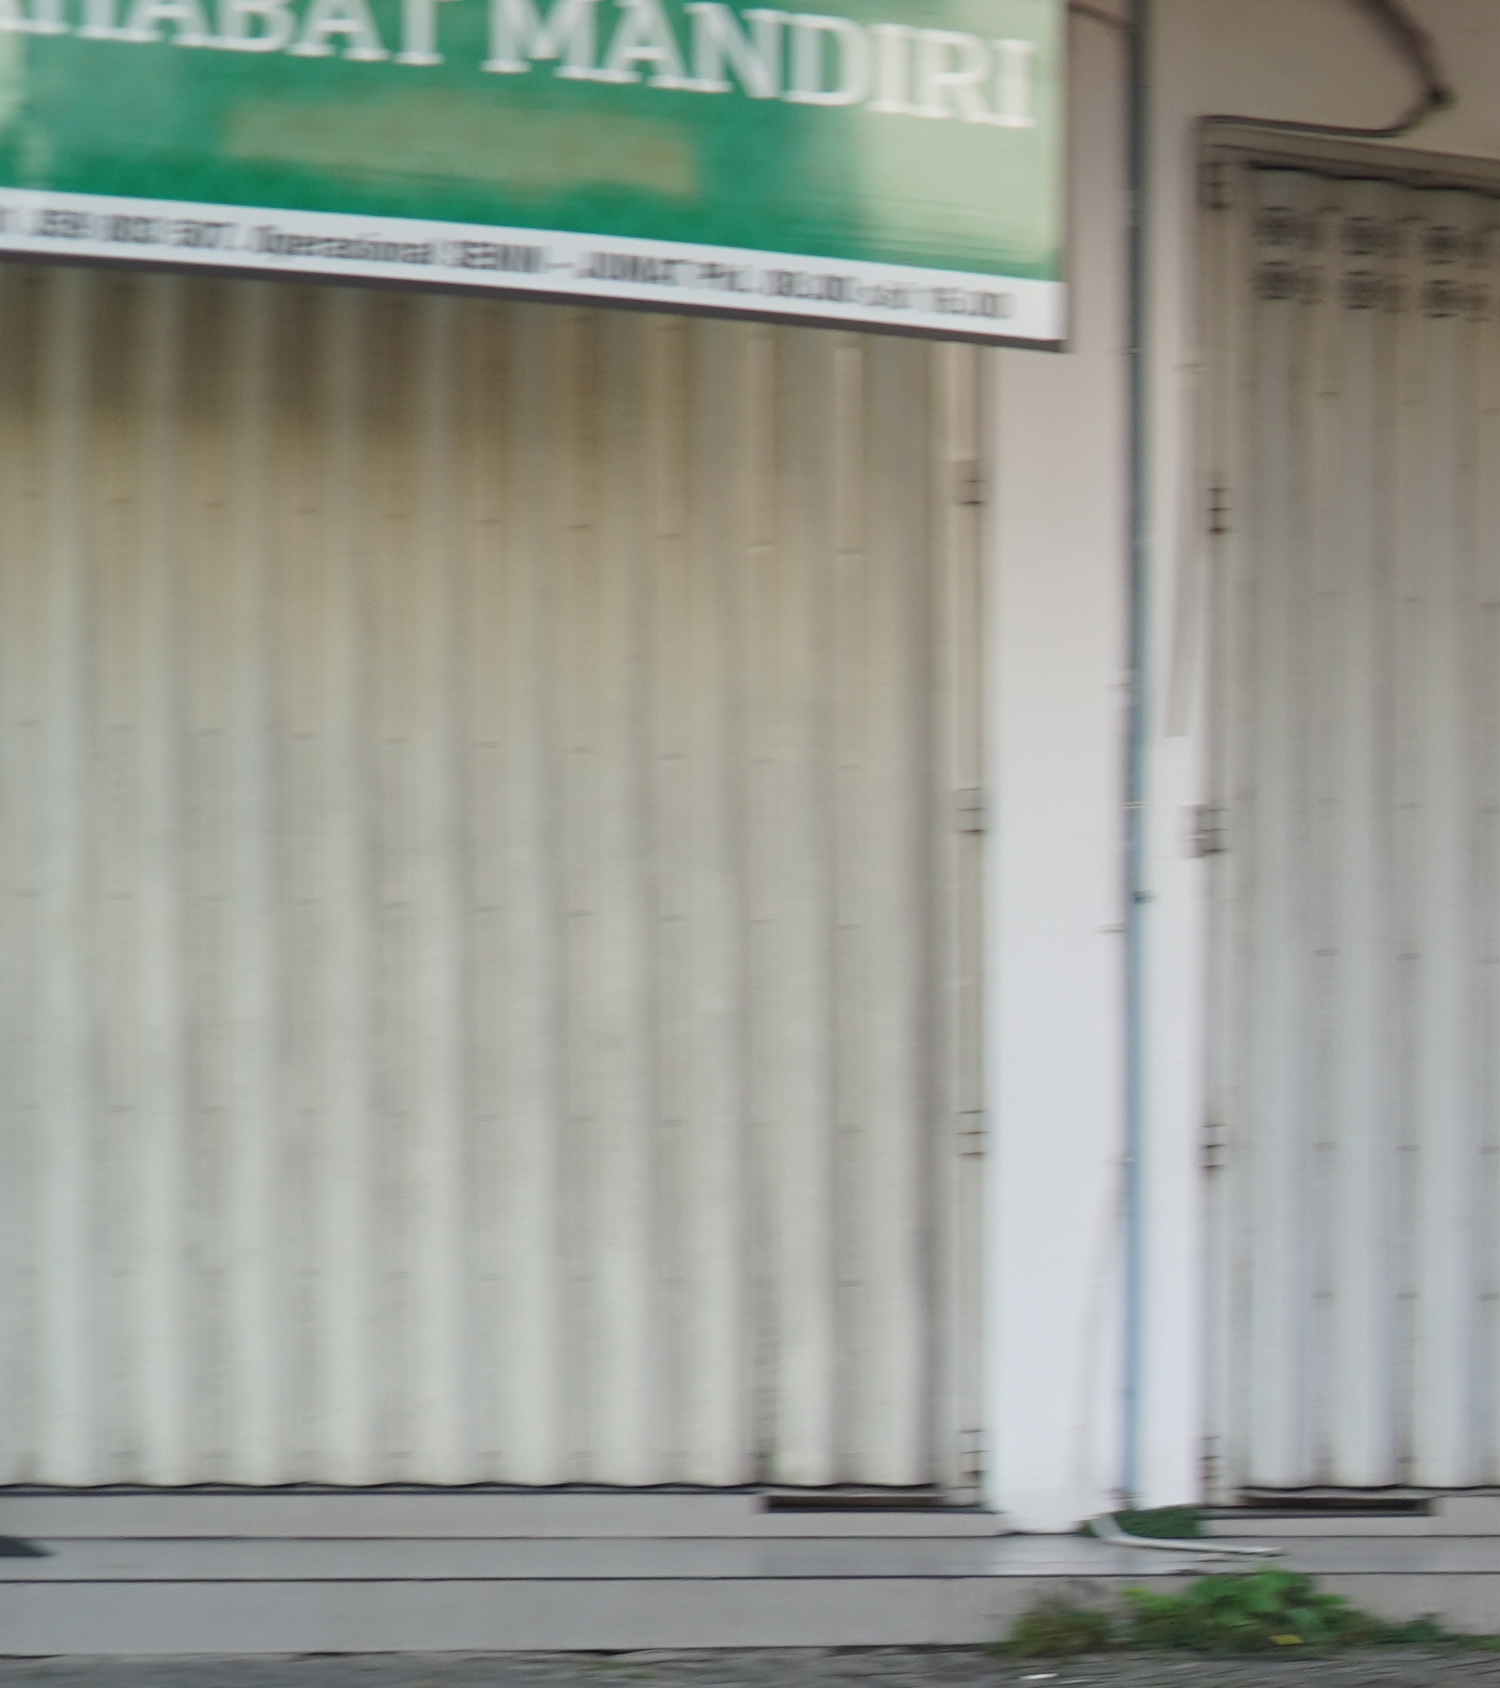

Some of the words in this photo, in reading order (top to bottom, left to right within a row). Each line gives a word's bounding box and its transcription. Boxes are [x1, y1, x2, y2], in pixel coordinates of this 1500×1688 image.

[480, 0, 1035, 128] MANDIRI
[250, 222, 438, 267] Operasional
[449, 238, 544, 275] SENIN
[577, 249, 687, 286] JUMAT
